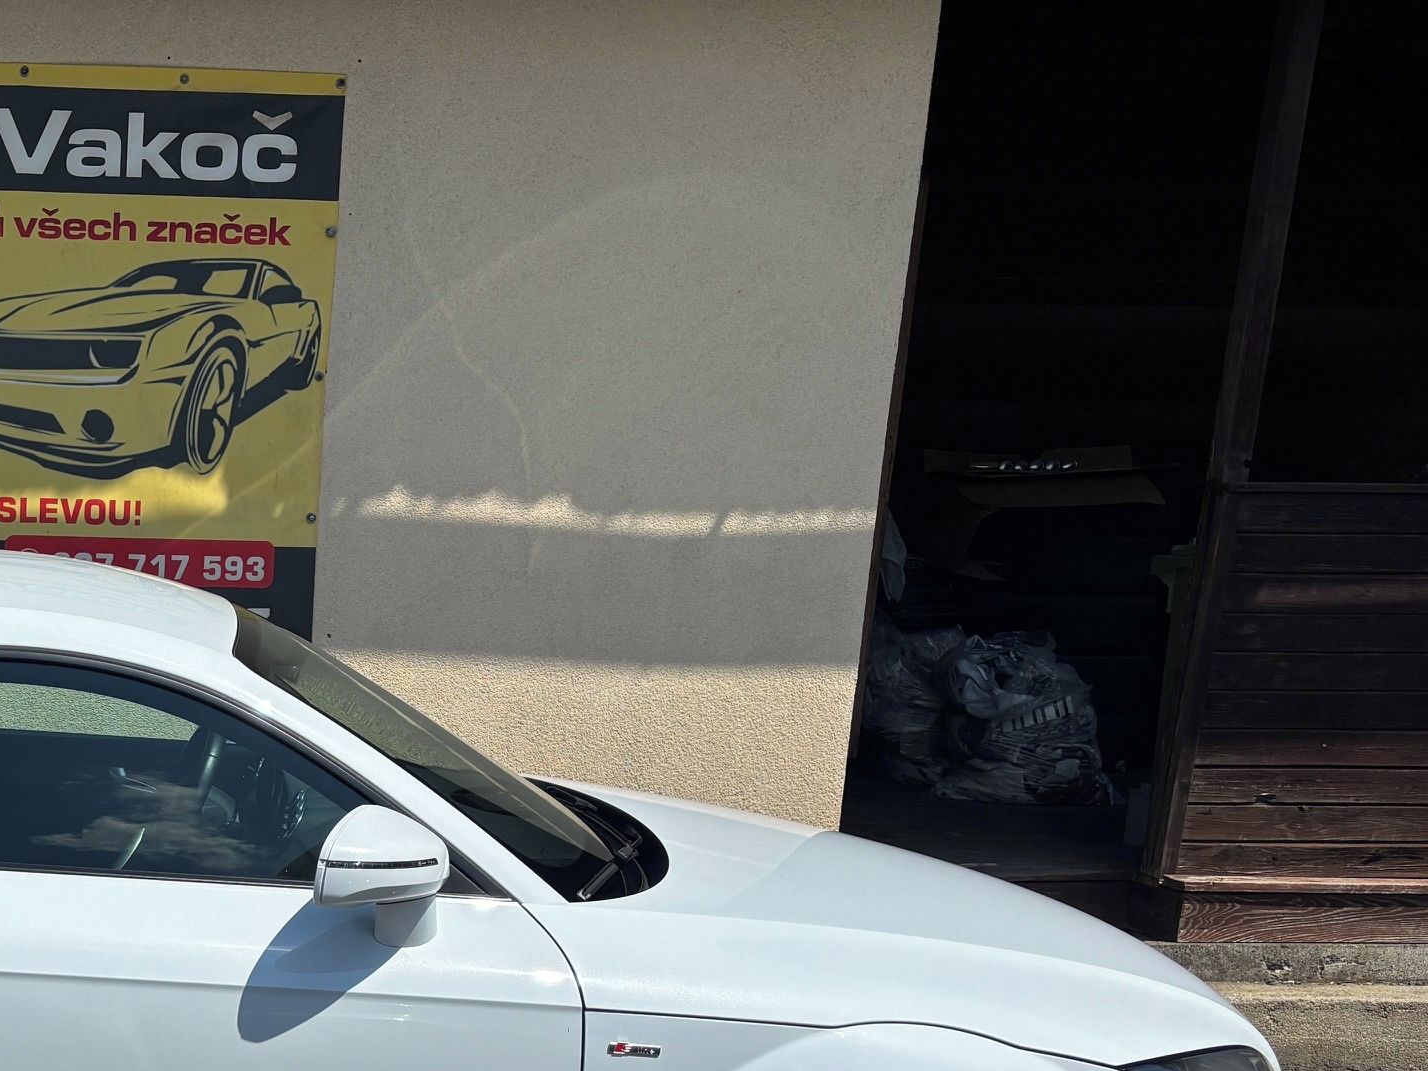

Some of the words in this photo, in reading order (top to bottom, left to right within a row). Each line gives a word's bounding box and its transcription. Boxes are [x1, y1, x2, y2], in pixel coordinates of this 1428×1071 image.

[14, 207, 137, 241] všech
[146, 213, 291, 246] značek
[128, 554, 189, 580] 717
[203, 556, 264, 581] 593
